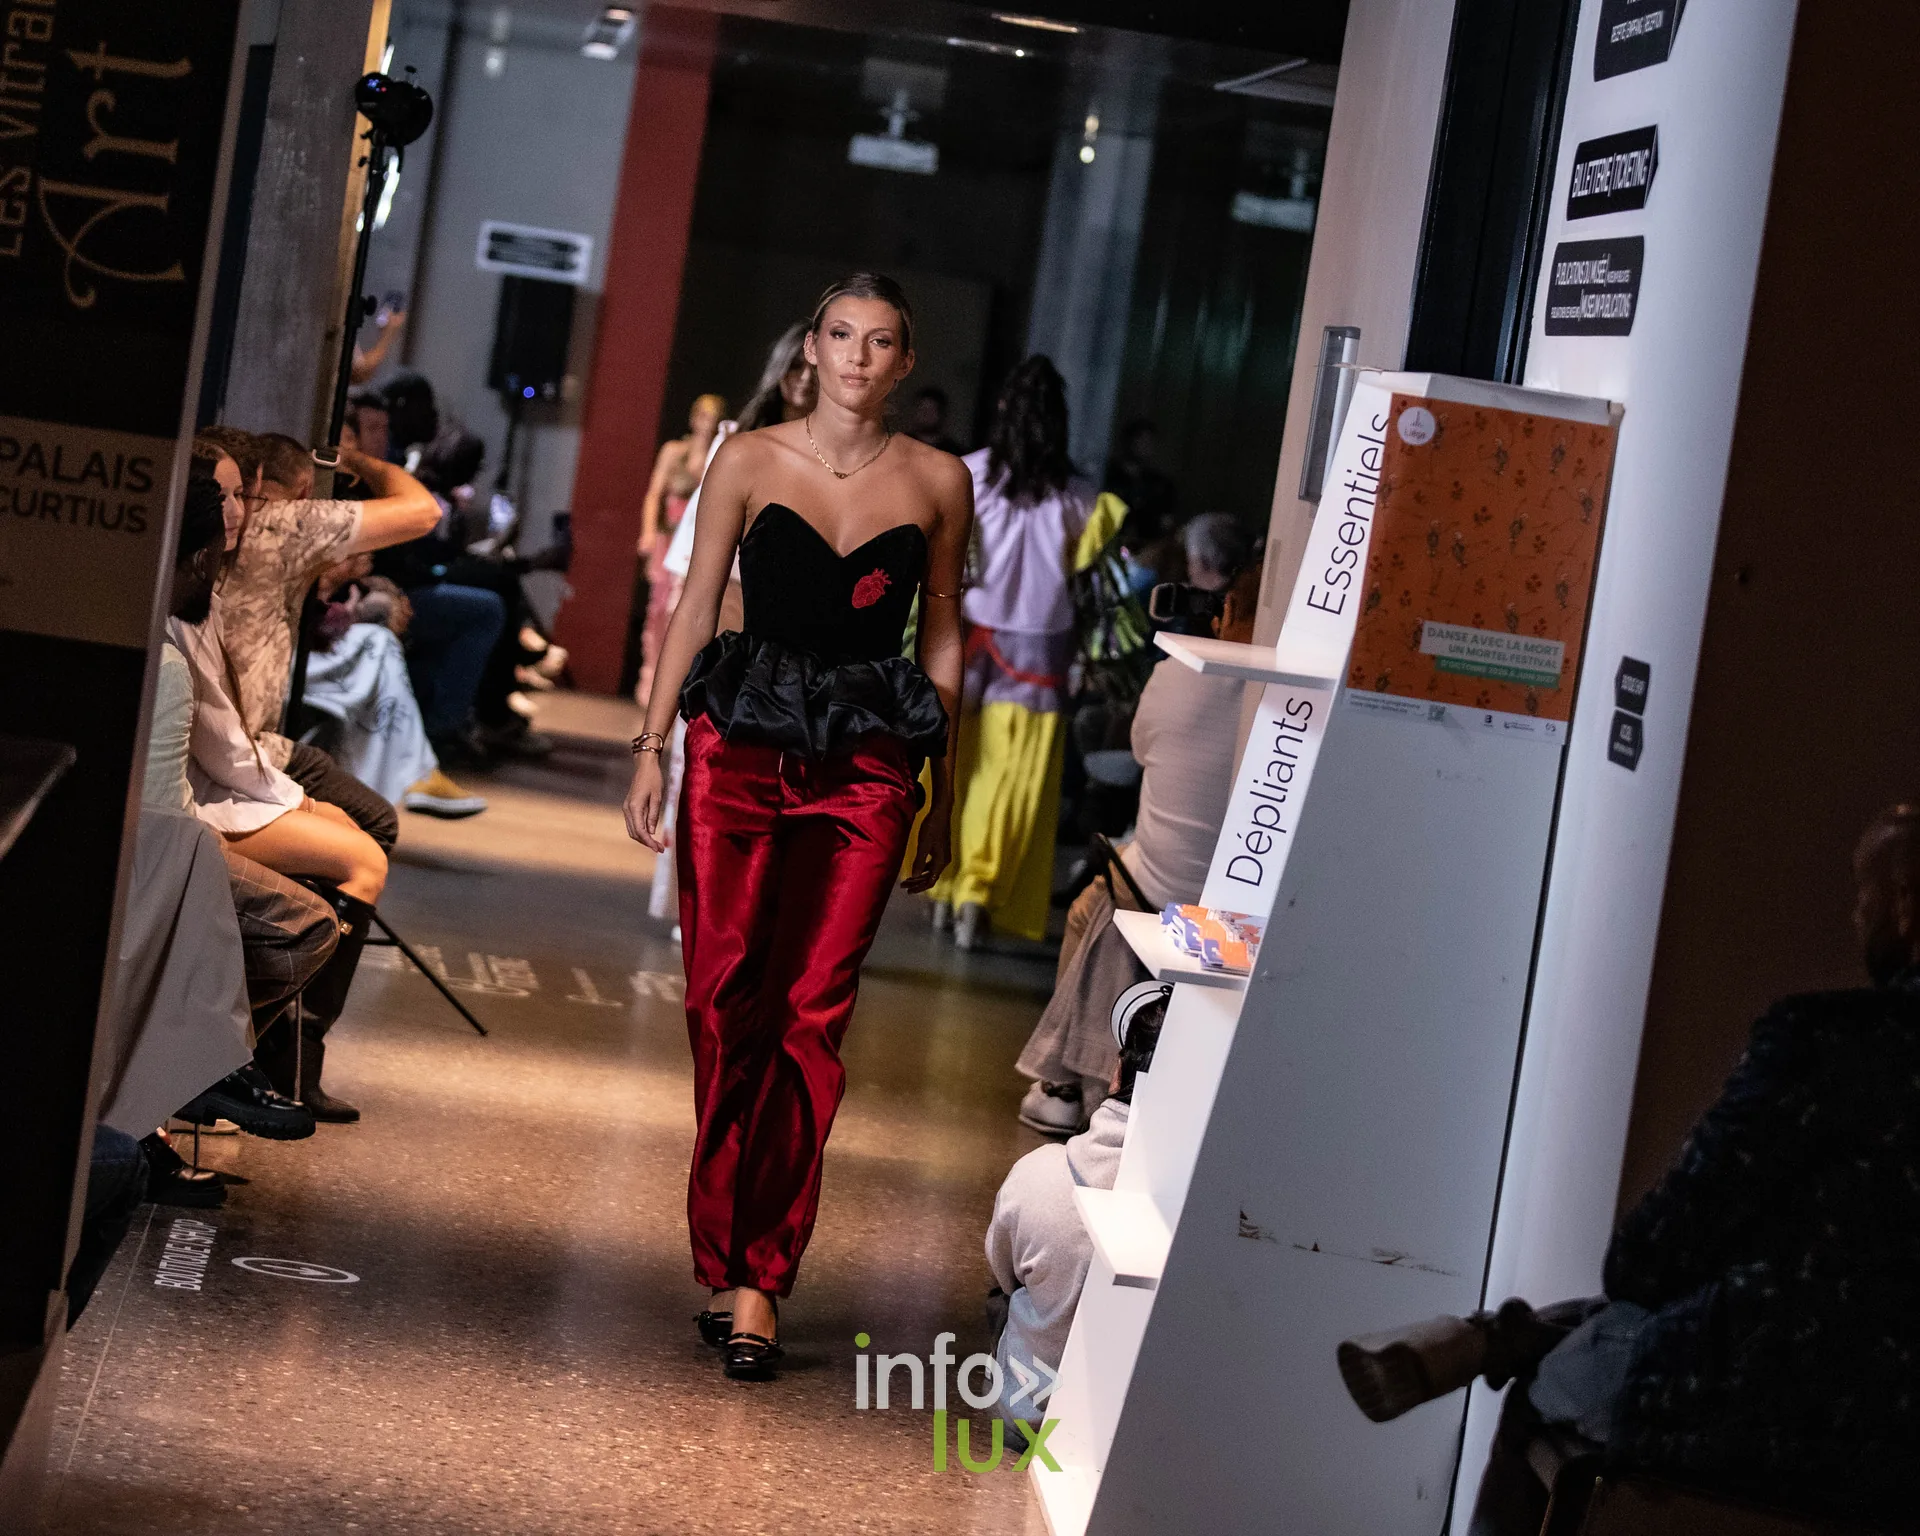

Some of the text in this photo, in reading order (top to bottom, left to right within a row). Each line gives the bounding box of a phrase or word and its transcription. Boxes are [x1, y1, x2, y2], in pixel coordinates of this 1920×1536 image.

[37, 40, 190, 309] Art
[0, 436, 153, 493] PALAIS
[1306, 413, 1389, 616] Essentiels
[1427, 627, 1560, 656] DANSE AVEC LA MORT
[1448, 644, 1557, 669] UN MORTEL FESTIVAL
[1226, 697, 1313, 886] Dépliants
[154, 1218, 218, 1291] BOUTIQUE SHOP
